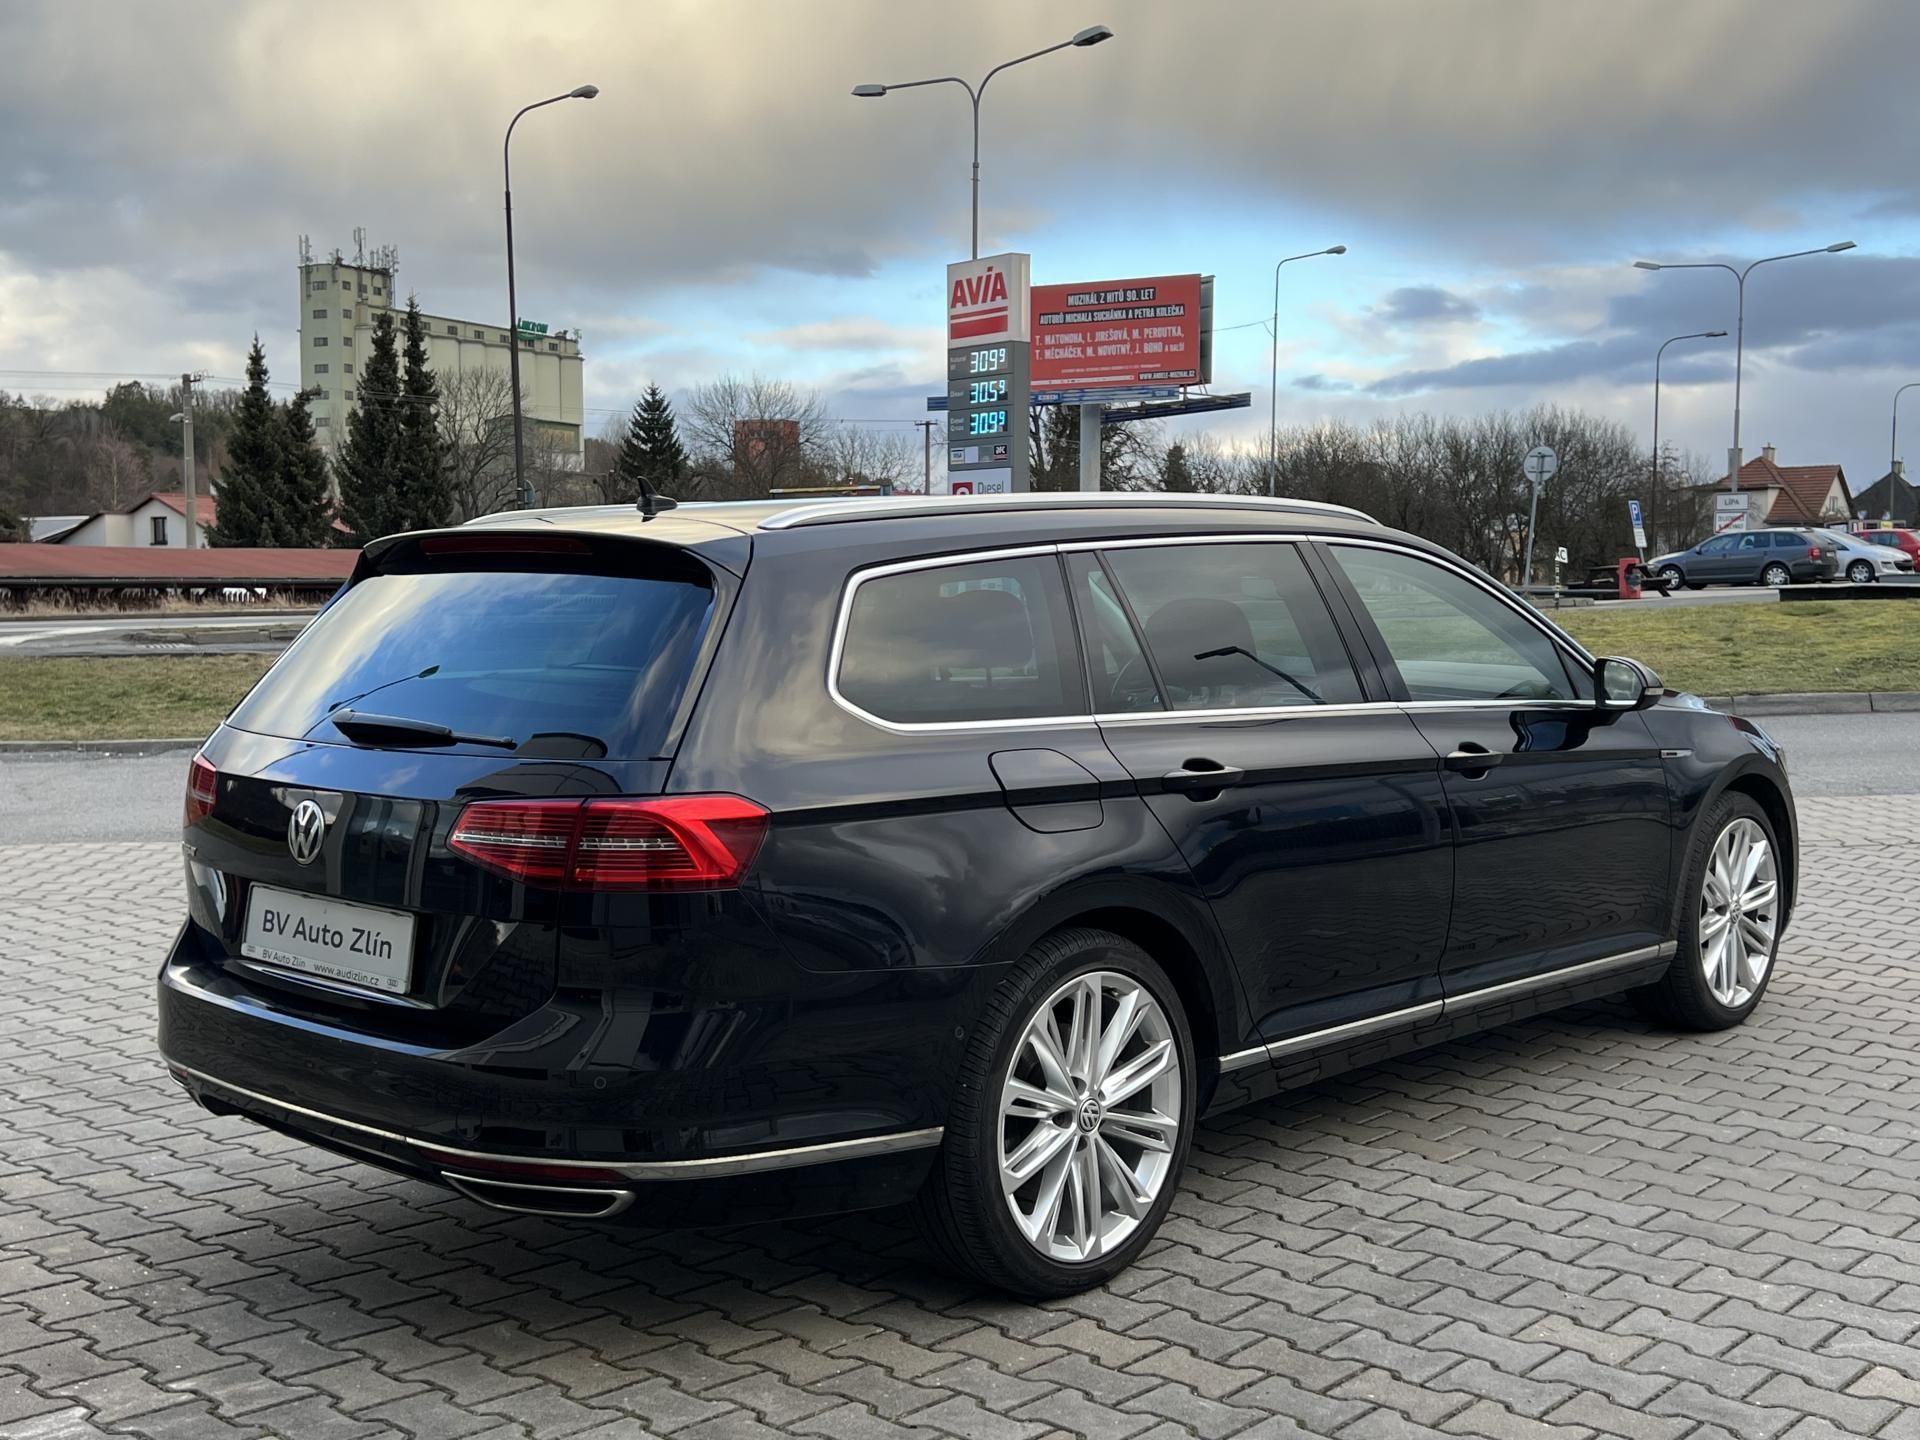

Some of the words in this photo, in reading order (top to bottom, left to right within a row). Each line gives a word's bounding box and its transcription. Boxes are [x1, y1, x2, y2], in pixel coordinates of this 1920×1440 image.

[1068, 292, 1098, 305] MUZIKÁL
[1100, 293, 1105, 304] Z
[1106, 289, 1124, 303] HITŮ
[1126, 290, 1139, 302] 90.
[1141, 288, 1155, 300] LET
[1065, 312, 1092, 323] MICHALA
[1093, 309, 1126, 322] SUCHÁNKA
[1128, 309, 1133, 319] A
[1134, 307, 1155, 319] PETRA
[1156, 305, 1184, 317] KOLEČKA
[1632, 504, 1638, 520] P
[262, 909, 290, 934] BV
[292, 916, 344, 949] Auto
[350, 927, 392, 960] Zlín
[262, 949, 272, 960] BV
[273, 951, 290, 965] Auto
[314, 962, 380, 986] www.audizlin.cz
